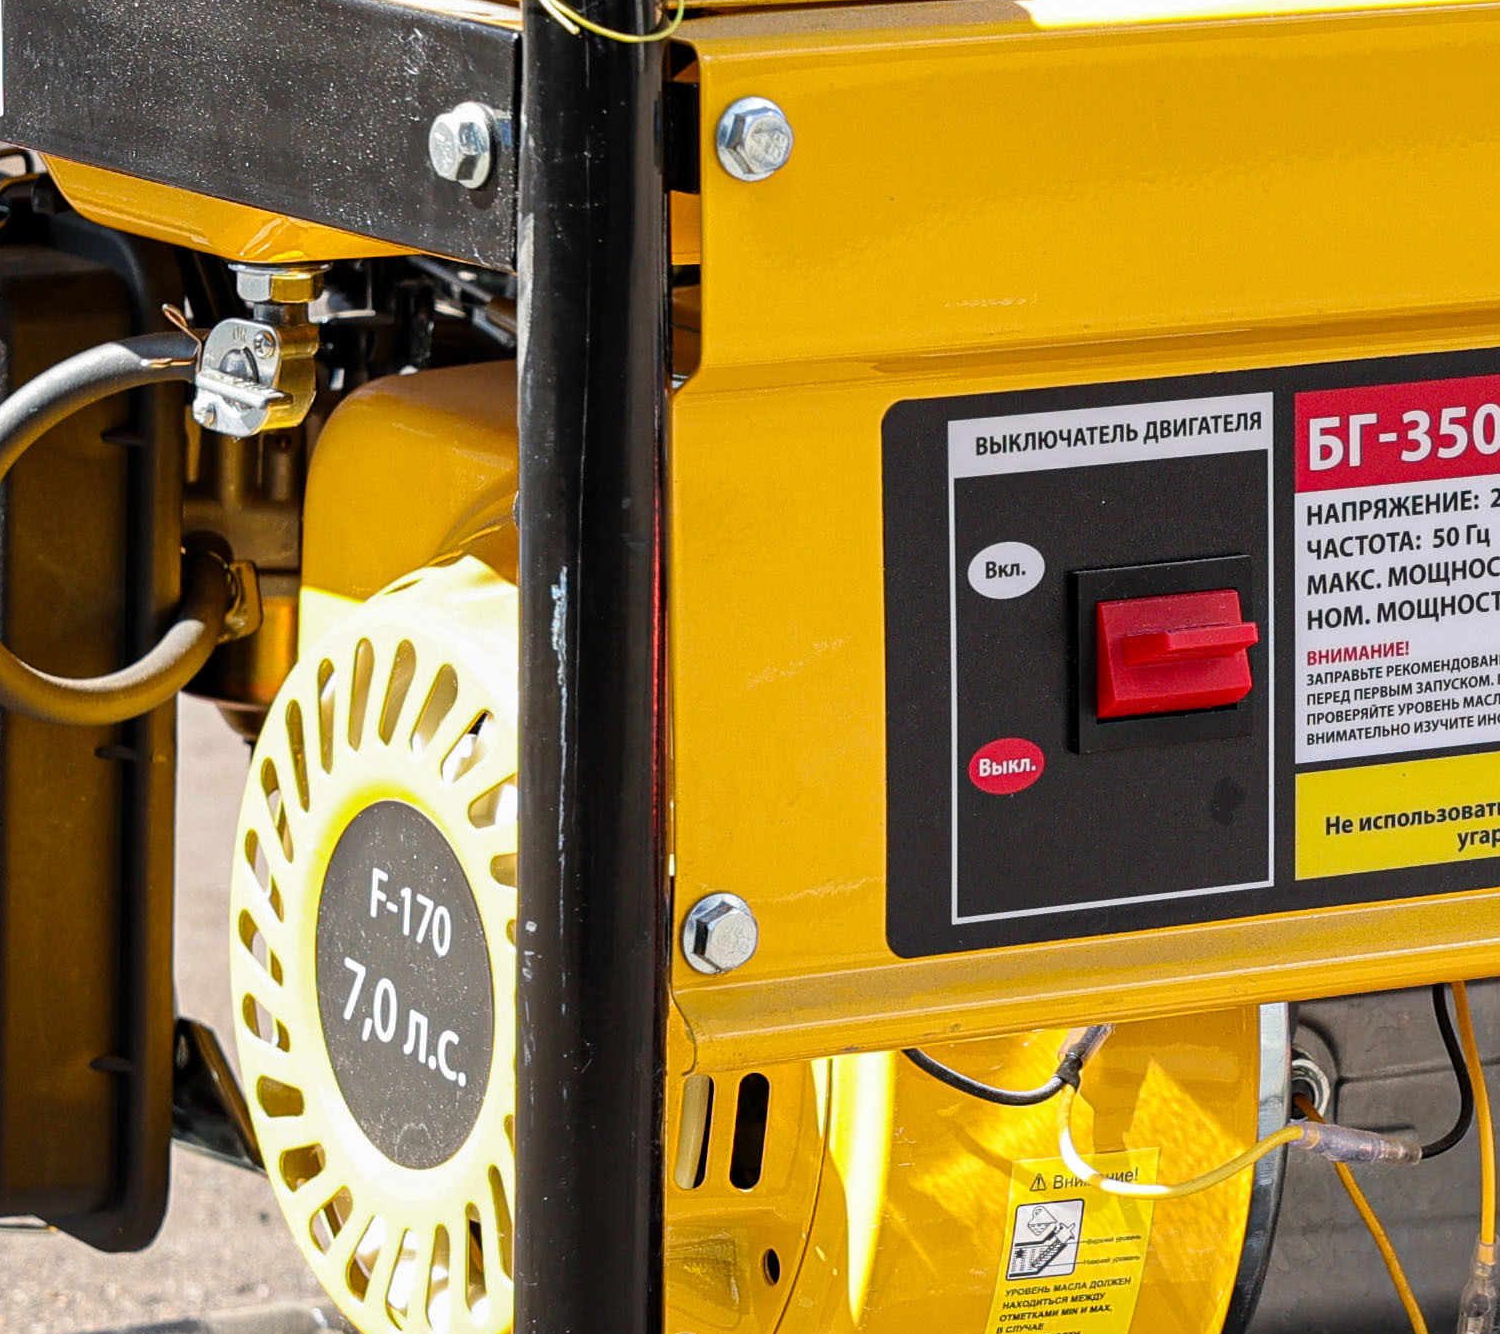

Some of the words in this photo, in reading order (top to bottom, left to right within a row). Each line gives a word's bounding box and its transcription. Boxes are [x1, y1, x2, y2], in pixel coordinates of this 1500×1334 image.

[975, 423, 1139, 456] ВЫКЛЮЧАТЕЛЬ
[1143, 411, 1263, 445] ДВИГАТЕЛЯ
[1306, 490, 1480, 526] НАПРЯЖЕНИЕ:
[1306, 530, 1422, 561] ЧАСТОТА:
[1432, 526, 1460, 549] 50
[1466, 524, 1491, 547] Гц
[985, 560, 1026, 580] Вкл.
[1306, 568, 1382, 596] МАКС.
[1306, 606, 1371, 631] НОМ.
[1306, 641, 1410, 666] ВНИМАНИЕ!
[1306, 666, 1383, 686] ЗАПРАВЬТЕ
[1306, 689, 1351, 706] ПЕРЕД
[1353, 682, 1413, 701] ПЕРВЫМ
[1416, 675, 1494, 695] ЗАПУСКОМ.
[1306, 703, 1394, 726] ПРОВЕРЯЙТЕ
[1397, 699, 1460, 717] УРОВЕНЬ
[1306, 723, 1411, 746] ВНИМАТЕЛЬНО
[1413, 715, 1475, 734] ИЗУЧИТЕ
[978, 757, 1037, 777] Выкл.
[1325, 816, 1354, 835] Не
[369, 867, 451, 957] F-170
[343, 956, 398, 1043] 7,0
[403, 1009, 467, 1087] л.с.
[1005, 1286, 1051, 1297] УРОВЕНЬ
[1053, 1282, 1087, 1293] МАСЛА
[1089, 1277, 1132, 1289] ДОЛЖЕН
[1002, 1296, 1069, 1309] НАХОДИТЬСЯ
[1070, 1293, 1106, 1303] МЕЖДУ
[999, 1310, 1059, 1322] ОТМЕТКАМИ
[1005, 1323, 1045, 1334] СЛУЧАЕ
